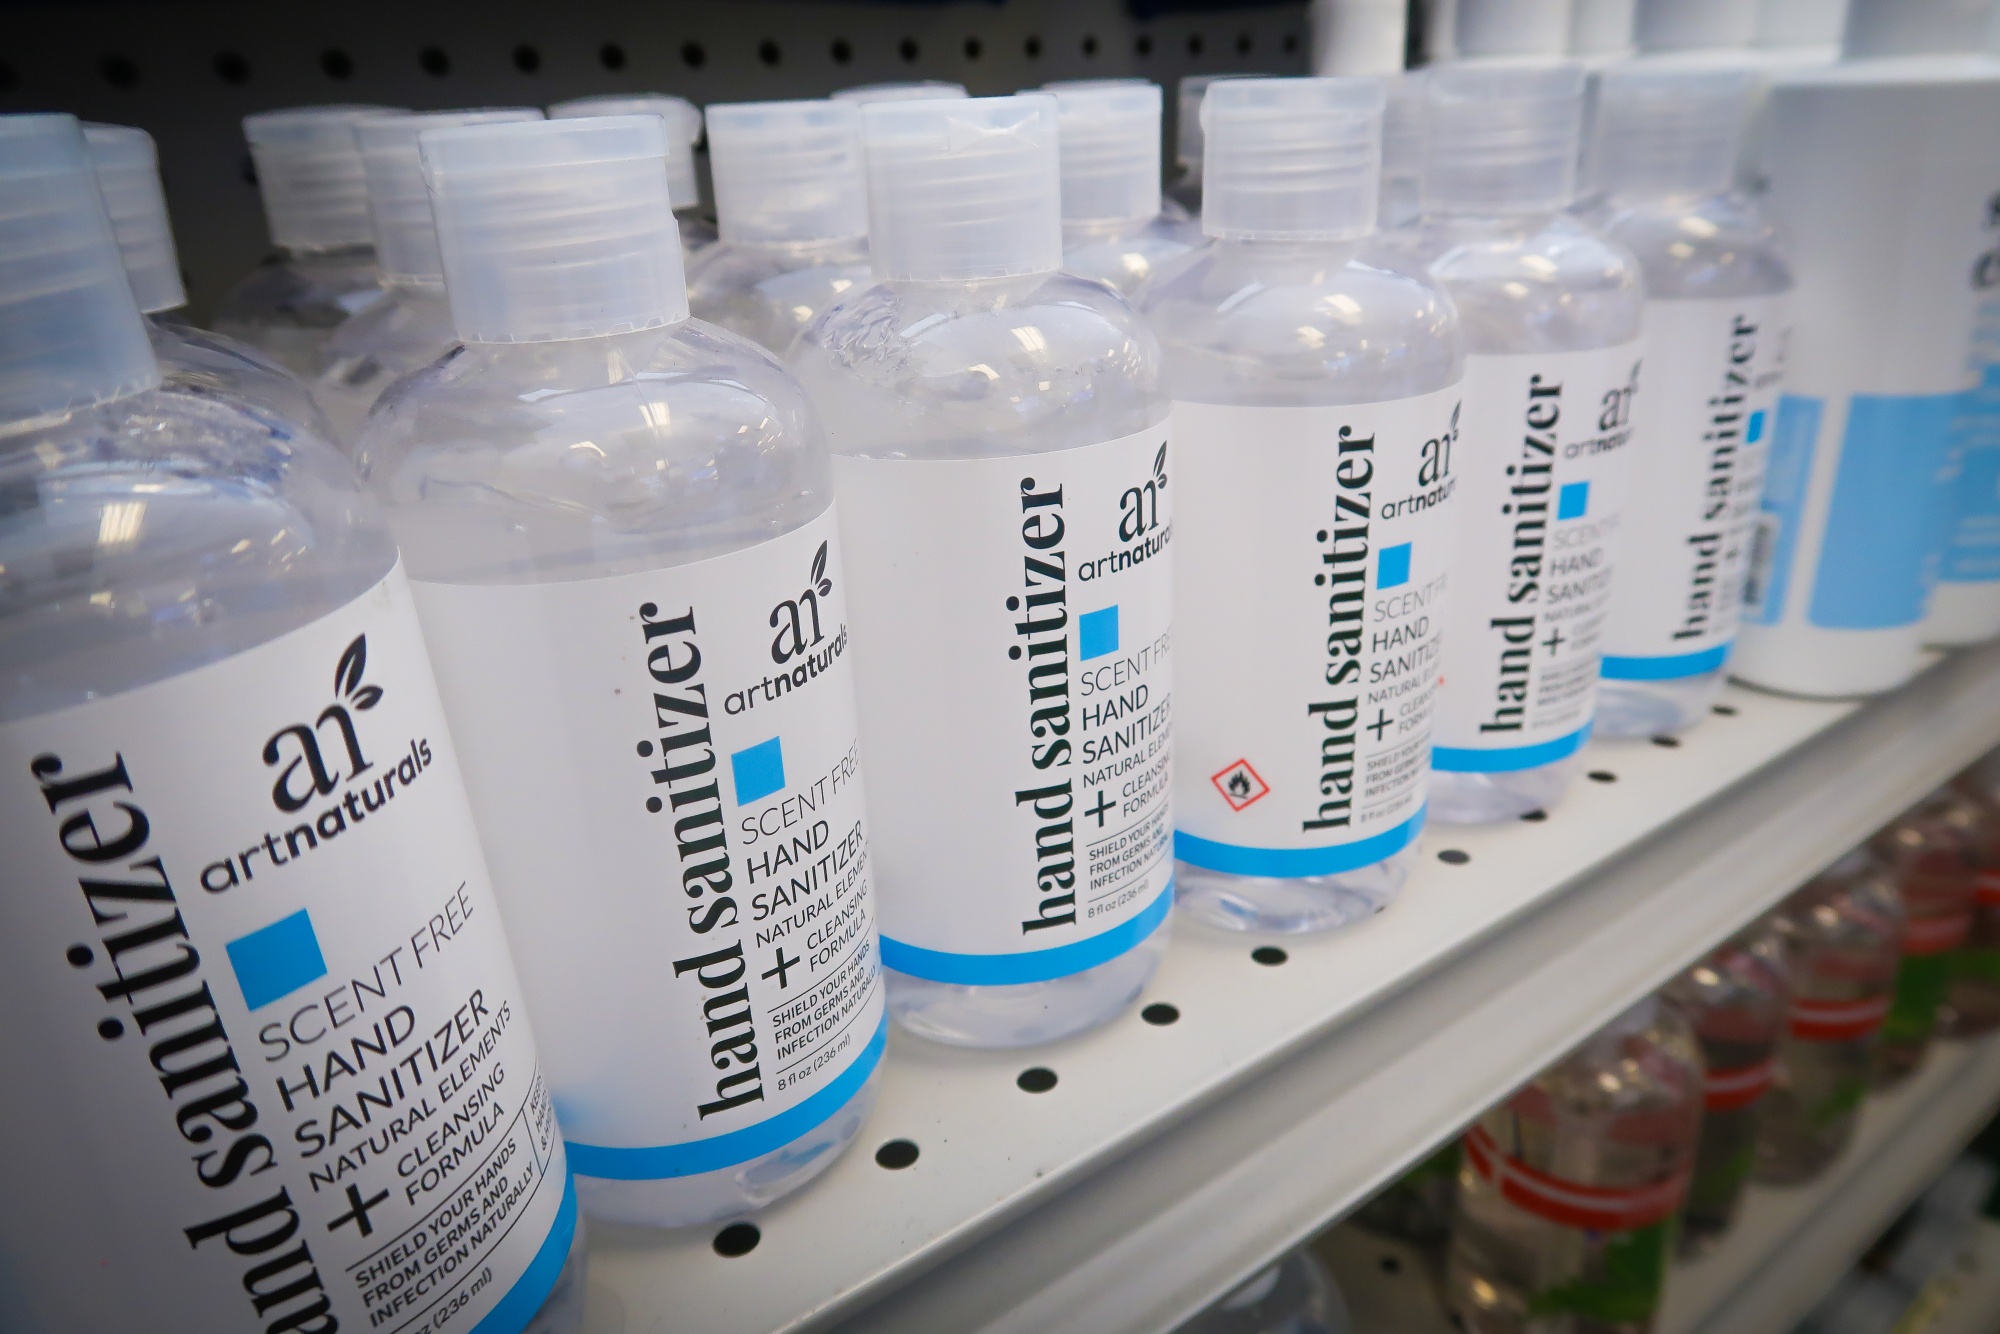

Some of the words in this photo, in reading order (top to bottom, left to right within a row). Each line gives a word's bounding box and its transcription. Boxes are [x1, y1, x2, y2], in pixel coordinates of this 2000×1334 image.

[1502, 374, 1562, 603] sanitizer
[1314, 425, 1375, 686] sanitizer
[724, 622, 847, 715] artnaturals
[1006, 477, 1072, 770] sanitizer
[1080, 645, 1151, 696] SCENT
[1372, 616, 1429, 653] HAND
[1479, 617, 1535, 733] hand
[1082, 684, 1149, 731] HAND
[200, 737, 432, 894] artnaturals
[636, 602, 739, 934] sanitizer
[741, 775, 828, 845] SCENT
[831, 737, 860, 795] FREE
[1083, 750, 1147, 788] NATURAL
[1302, 695, 1359, 833] hand
[746, 820, 829, 884] HAND
[751, 820, 863, 921] SANITIZER
[1015, 777, 1077, 936] hand
[1089, 837, 1127, 861] SHIELD
[1128, 822, 1150, 844] YOUR
[1089, 855, 1120, 876] FROM
[1090, 857, 1142, 890] INFECTION
[755, 892, 833, 948] NATURAL
[807, 879, 867, 950] CLEANSING
[809, 908, 866, 972] FORMULA
[30, 751, 278, 1188] sanitizer
[258, 946, 402, 1062] SCENT
[410, 880, 474, 969] FREE
[772, 993, 818, 1028] SHIELD
[819, 970, 846, 1000] YOUR
[848, 939, 870, 977] HANDS
[774, 1014, 812, 1045] FROM
[814, 989, 849, 1021] GERMS
[849, 966, 865, 994] AND
[776, 1014, 840, 1061] INFECTION
[841, 963, 876, 1018] NATURALLY
[276, 1004, 415, 1112] HAND
[294, 989, 489, 1159] SANITIZER
[672, 938, 764, 1121] hand
[778, 1079, 786, 1091] 8
[798, 1065, 811, 1080] oz
[813, 1048, 836, 1072] (236
[837, 1033, 850, 1054] ml)
[308, 1098, 437, 1193] NATURAL
[437, 1000, 511, 1104] ELEMENTS
[397, 1062, 504, 1178] CLEANSING
[405, 1101, 504, 1206] FORMULA
[183, 1185, 340, 1334] and
[355, 1231, 427, 1289] SHIELD
[428, 1188, 475, 1236] YOUR
[474, 1137, 516, 1195] HANDS
[362, 1264, 421, 1308] FROM
[424, 1208, 480, 1265] GERMS
[482, 1175, 508, 1216] AND
[369, 1244, 470, 1328] INFECTION
[470, 1160, 534, 1250] NATURALLY
[433, 1289, 470, 1330] (236
[470, 1266, 493, 1297] ml)
